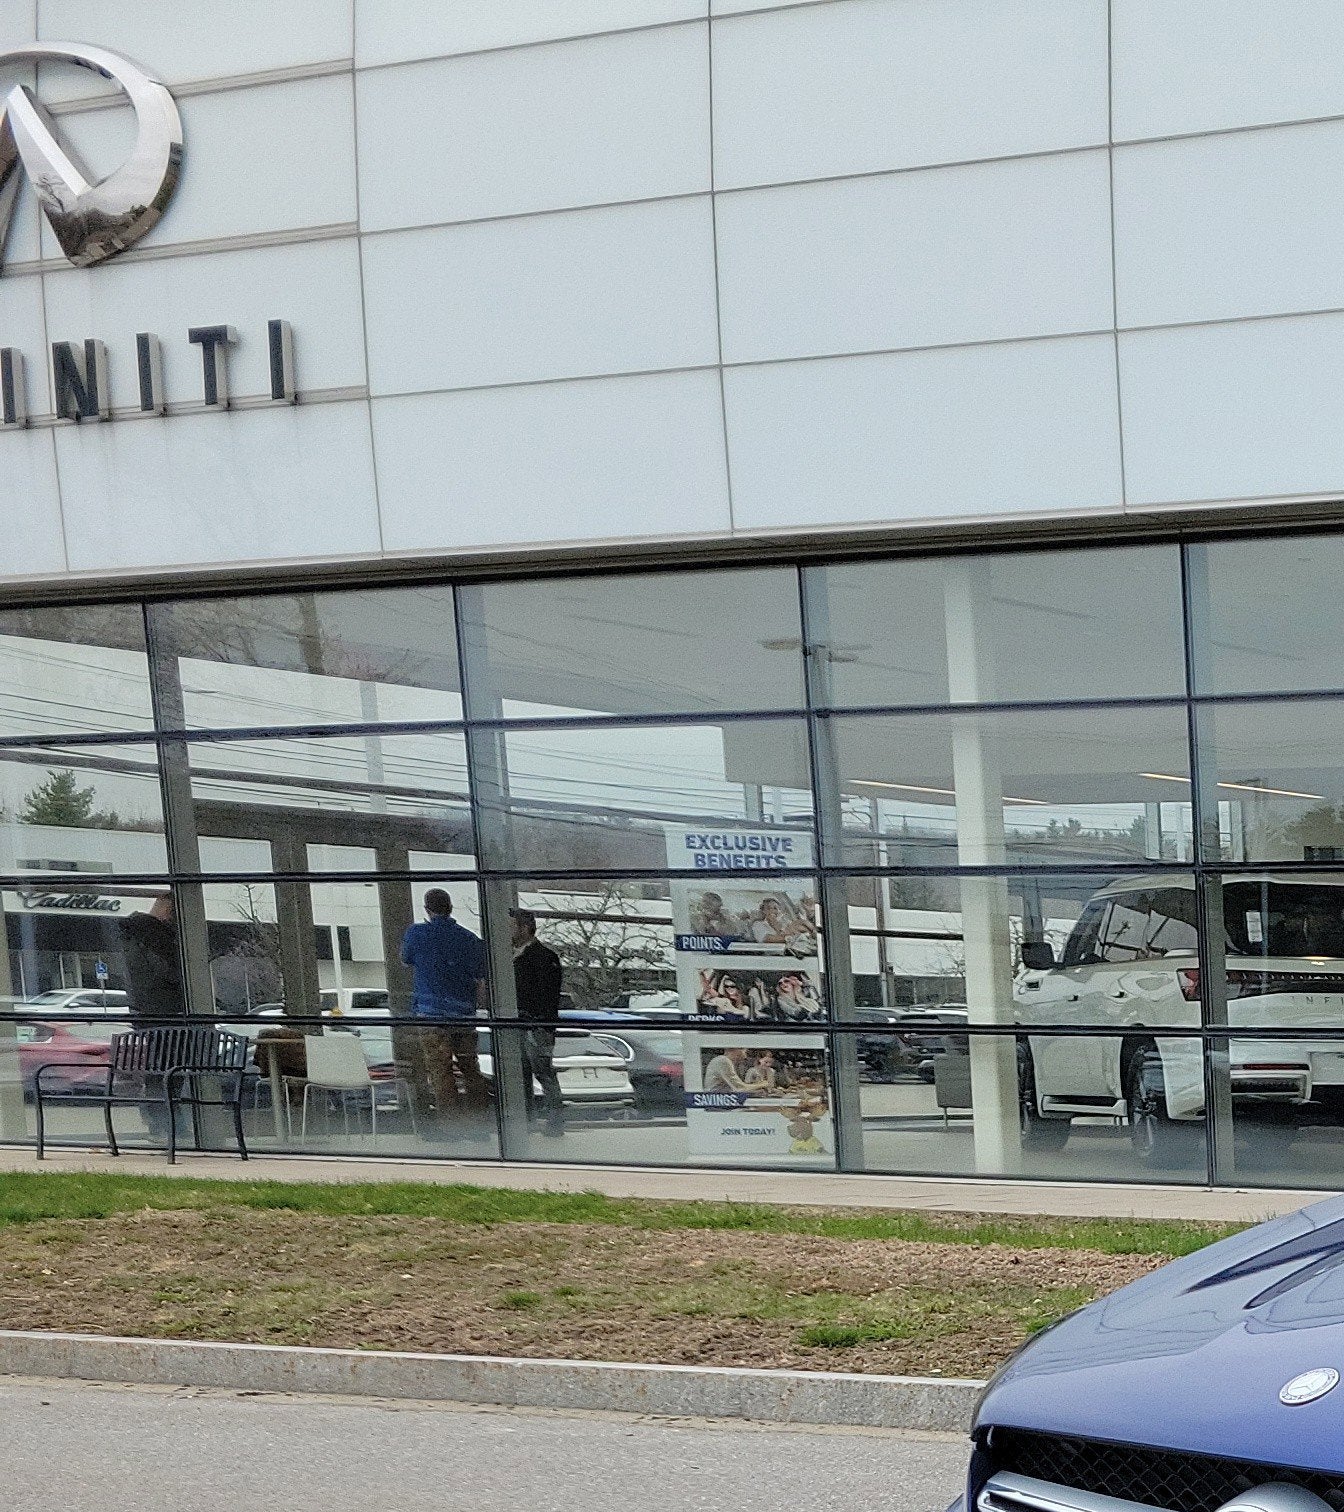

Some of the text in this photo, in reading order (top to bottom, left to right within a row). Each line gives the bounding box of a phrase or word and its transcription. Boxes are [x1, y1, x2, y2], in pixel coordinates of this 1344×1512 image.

[685, 833, 792, 852] EXCLUSIVE
[694, 852, 787, 868] BENEFITS
[17, 891, 121, 912] Cadillac
[721, 1128, 775, 1136] JOIN TODAY!
